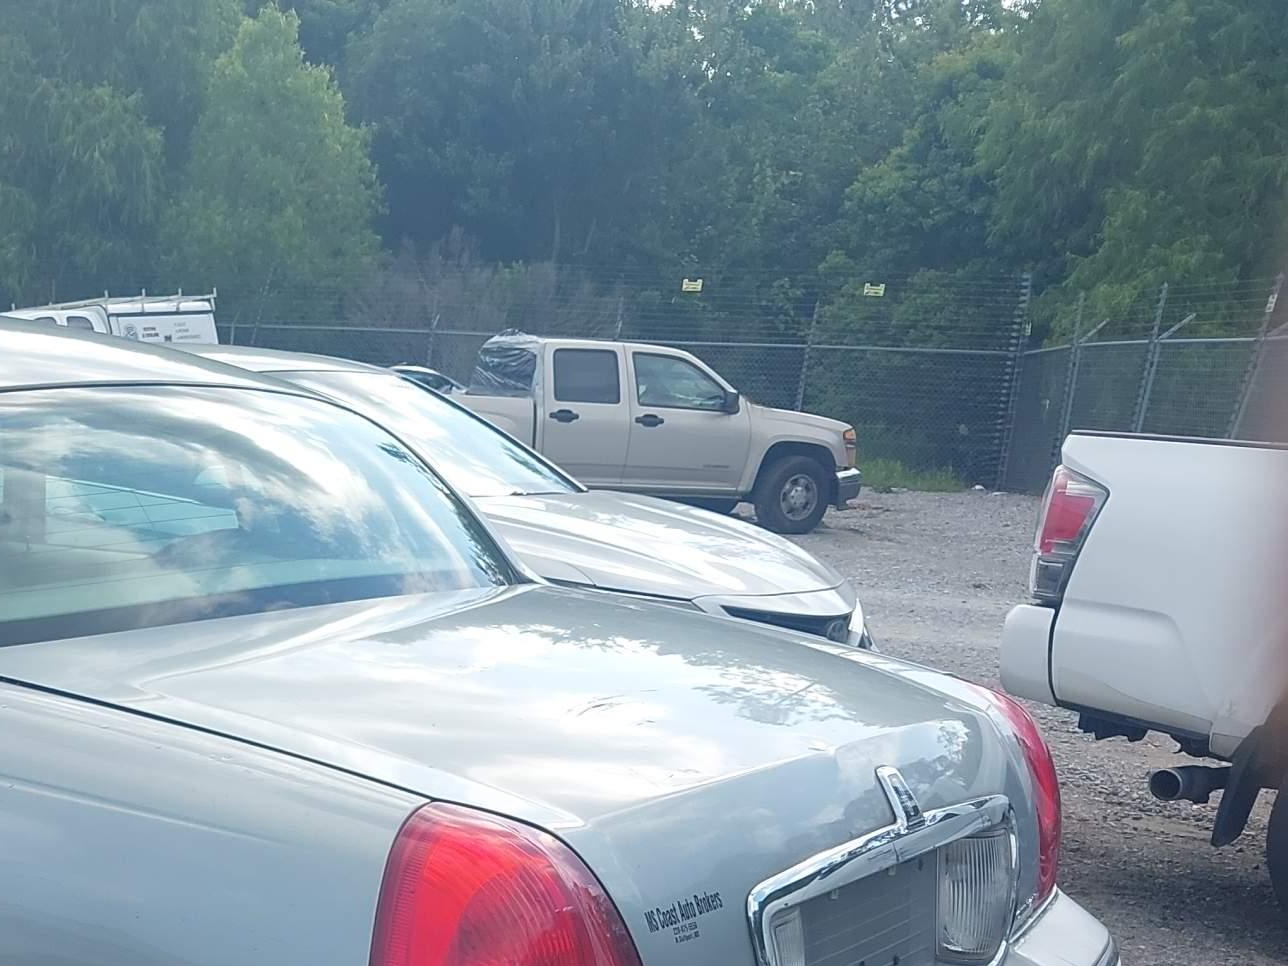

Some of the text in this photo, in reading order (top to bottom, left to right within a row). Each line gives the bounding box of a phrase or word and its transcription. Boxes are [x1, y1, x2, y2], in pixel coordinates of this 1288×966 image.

[644, 908, 660, 934] MS
[656, 902, 681, 930] Coast
[677, 898, 697, 923] Auto
[693, 891, 724, 916] Brokers
